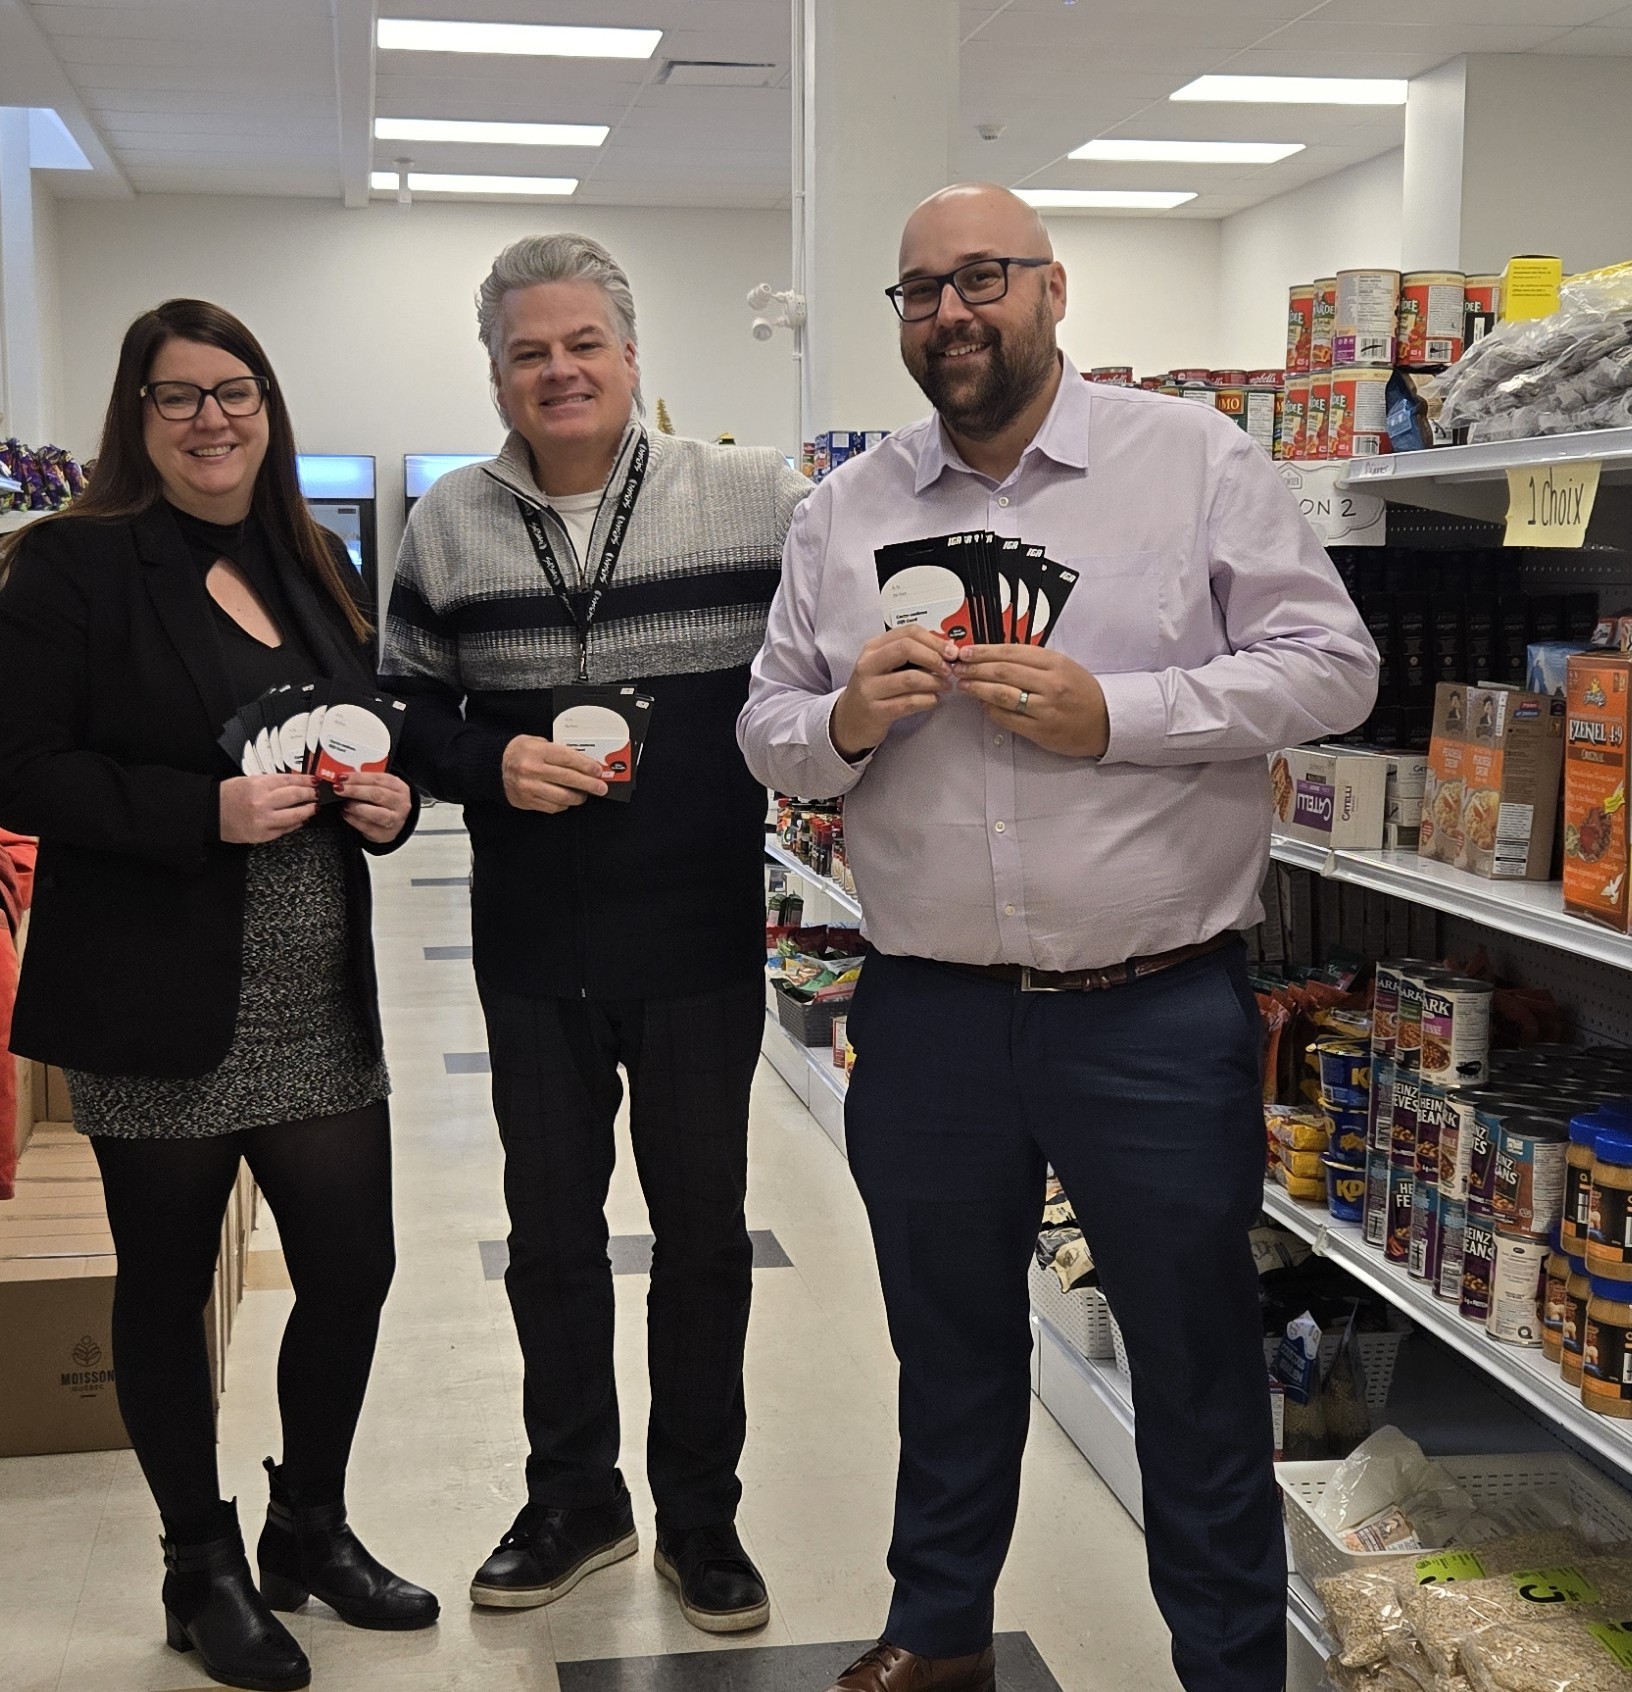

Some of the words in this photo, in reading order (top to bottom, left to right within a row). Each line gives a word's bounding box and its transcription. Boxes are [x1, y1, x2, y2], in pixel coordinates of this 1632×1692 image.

[1341, 498, 1357, 517] 2
[1527, 475, 1536, 525] 1
[1298, 793, 1332, 821] CATELLI
[1342, 786, 1352, 821] CATELLI
[1336, 1178, 1365, 1202] KD
[61, 1370, 115, 1385] MOISSON
